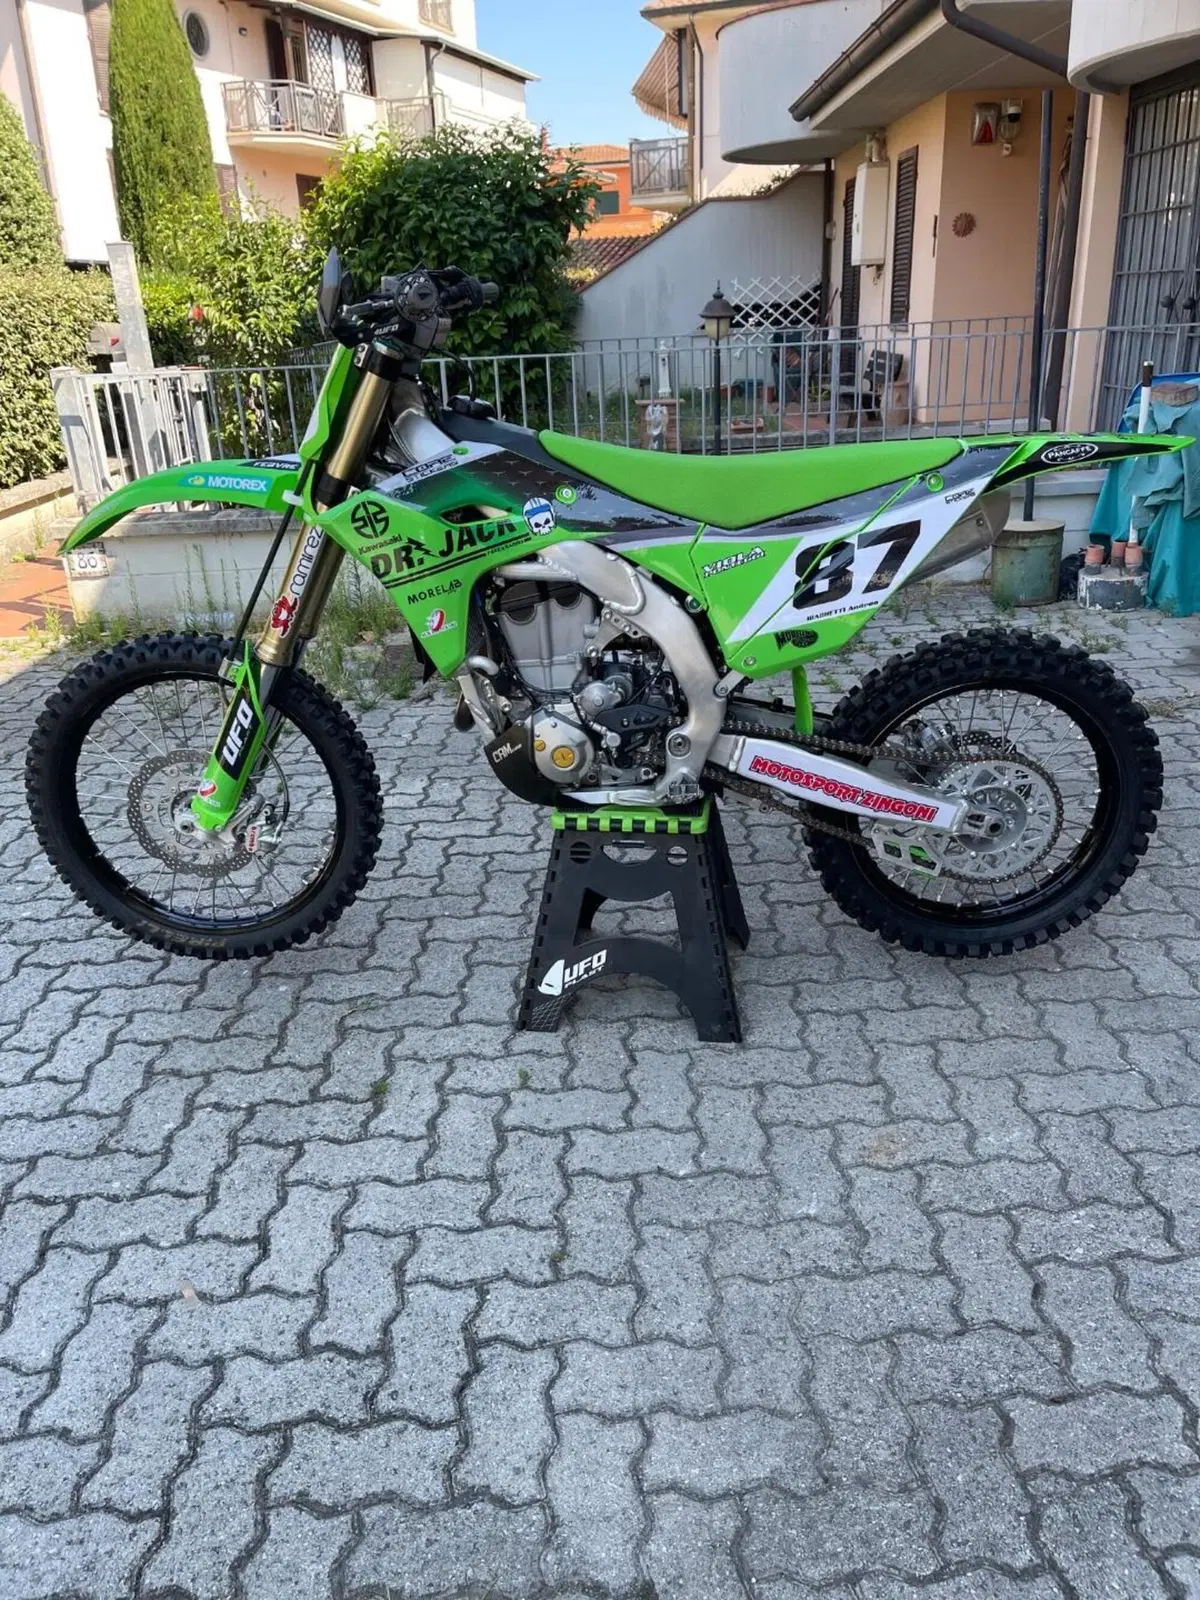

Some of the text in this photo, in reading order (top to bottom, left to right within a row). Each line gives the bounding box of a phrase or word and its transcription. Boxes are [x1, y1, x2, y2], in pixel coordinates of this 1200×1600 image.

[207, 475, 268, 492] MOTOREX
[358, 533, 403, 555] Kawasaki
[437, 518, 518, 559] JACK
[289, 526, 325, 596] ramirez
[792, 519, 921, 610] 87
[847, 600, 879, 611] Andrea
[222, 698, 254, 767] UFO
[749, 755, 939, 823] MOTOSPORT ZINGONI
[564, 949, 607, 984] UFO
